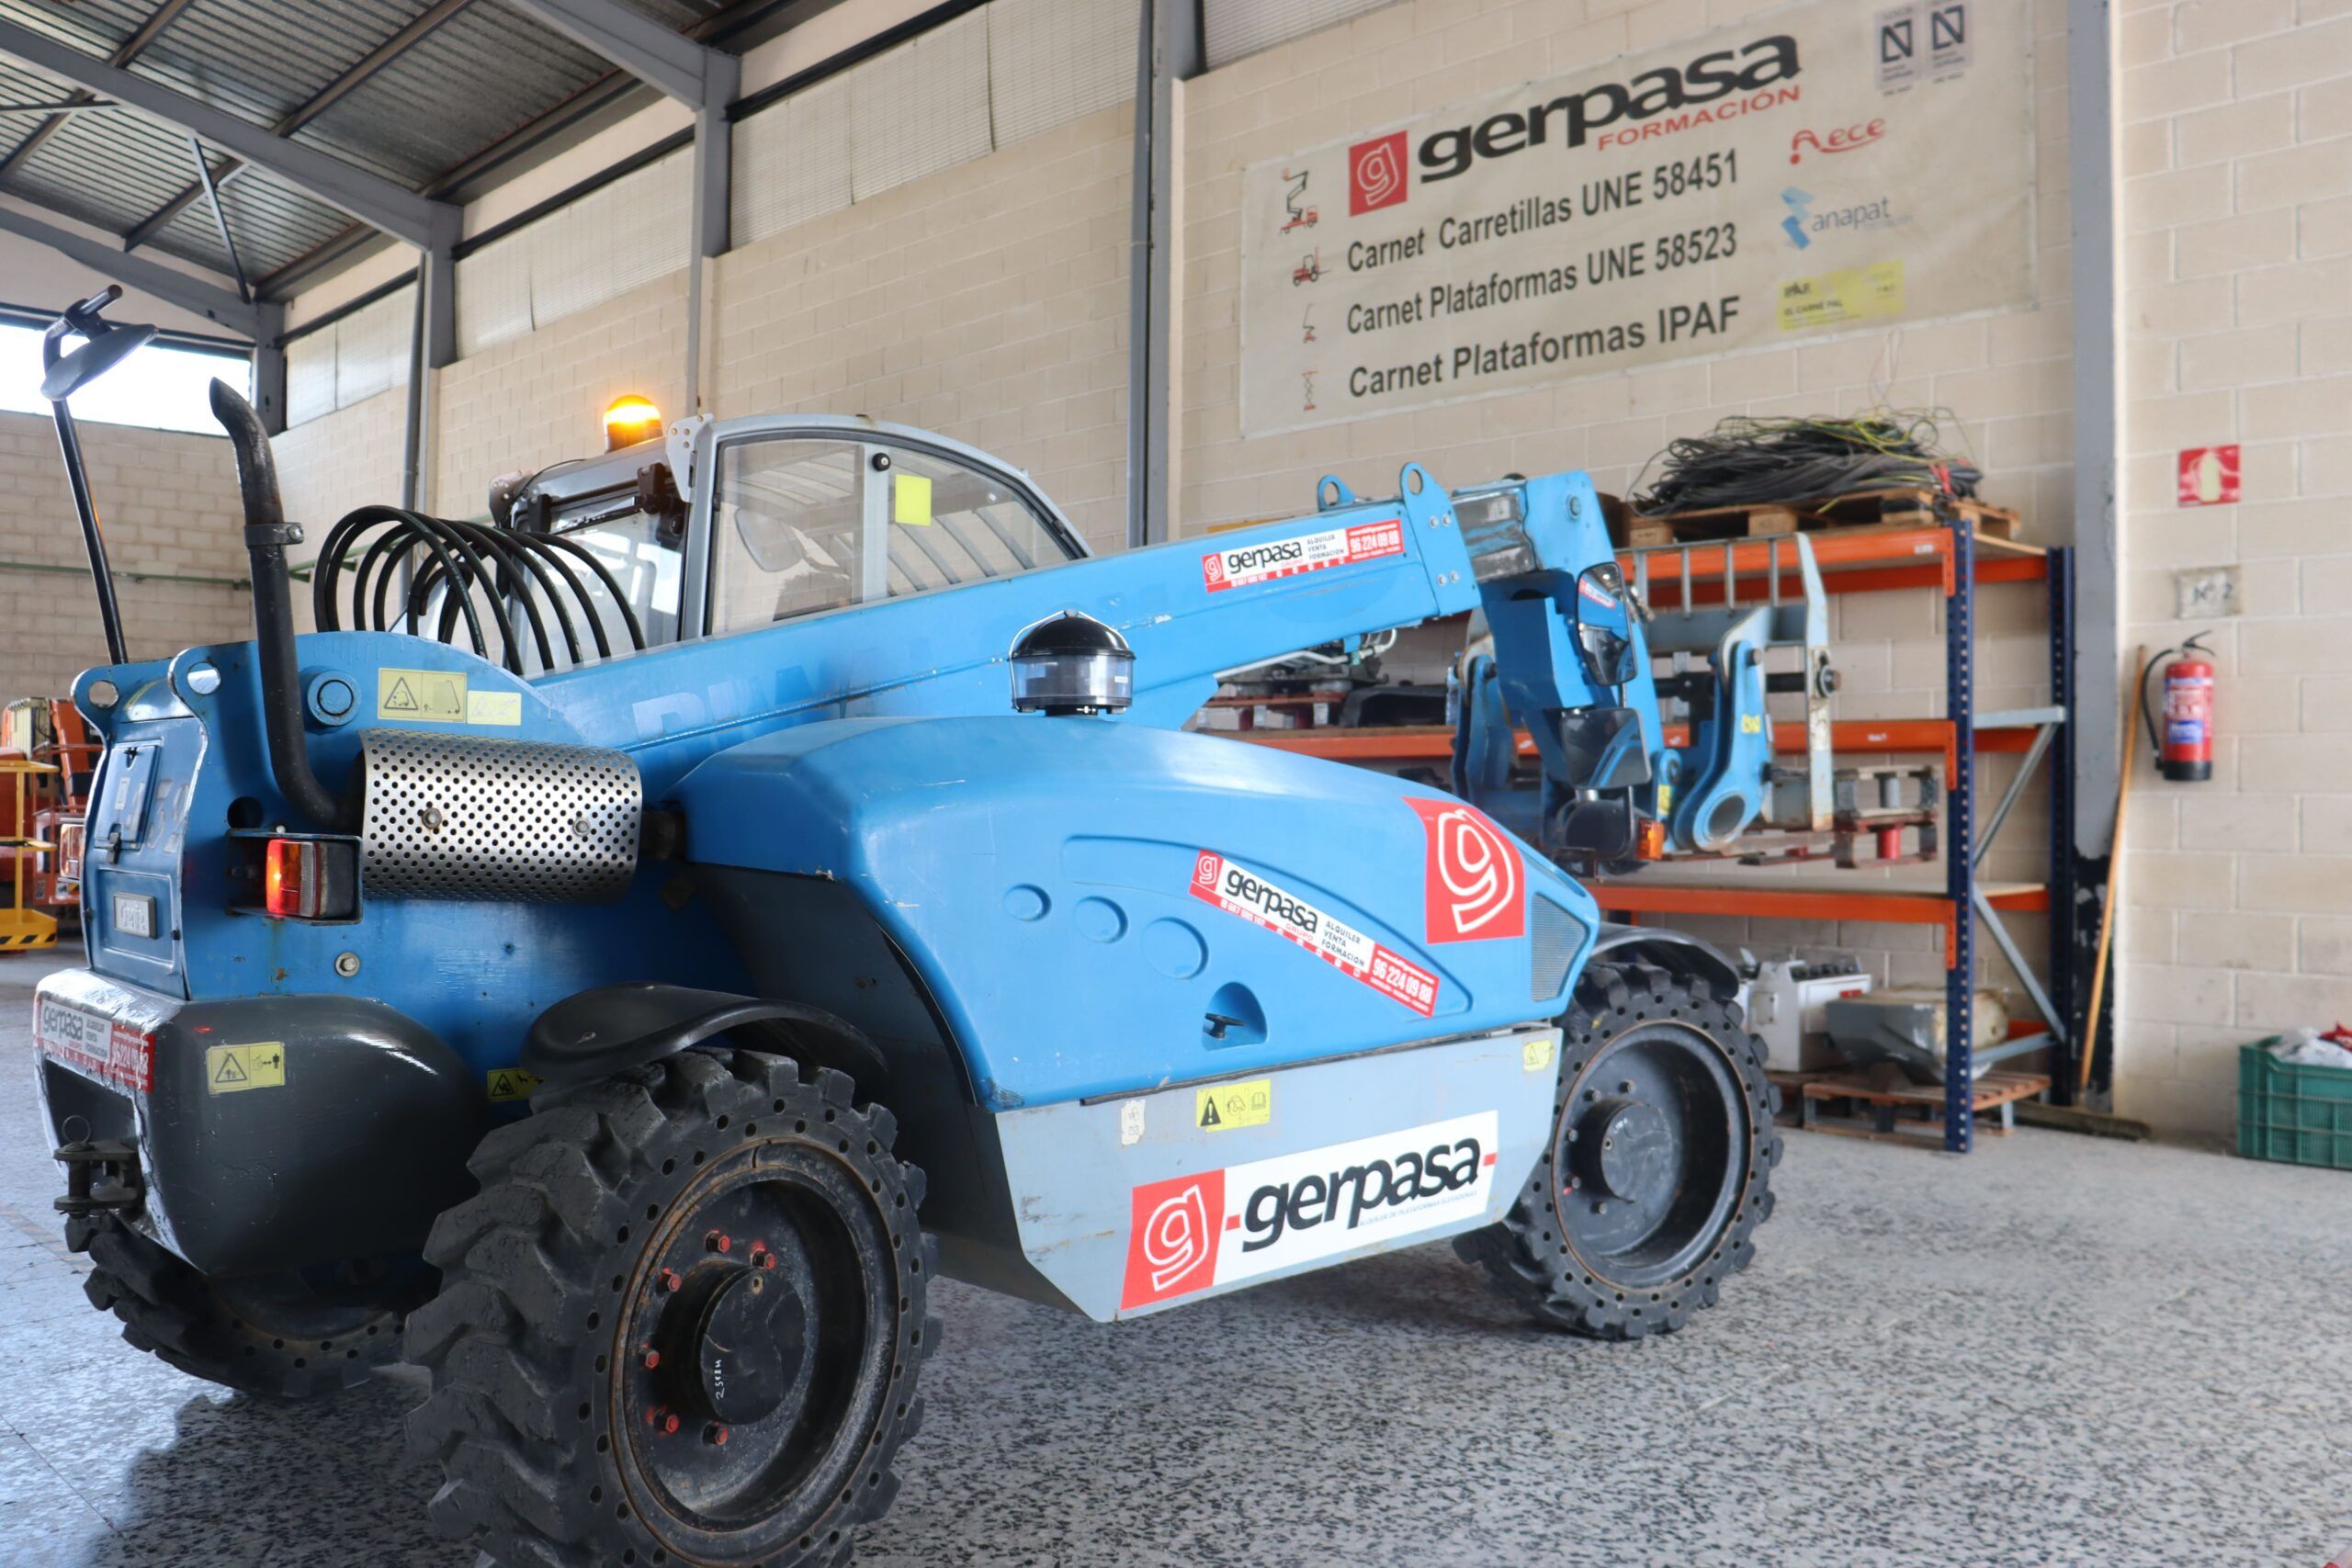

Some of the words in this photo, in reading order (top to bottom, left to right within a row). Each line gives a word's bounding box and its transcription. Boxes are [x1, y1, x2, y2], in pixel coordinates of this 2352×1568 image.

[1418, 35, 1802, 184] gerpasa
[1598, 85, 1801, 152] FORMACIÓN
[1347, 227, 1425, 273] Carnet
[1438, 197, 1572, 249] Carretillas
[1582, 172, 1643, 216] UNE
[1653, 148, 1738, 199] 58451
[1811, 196, 1892, 231] anapat
[1347, 289, 1423, 334] Carnet
[1430, 264, 1577, 318] Plataformas
[1586, 242, 1645, 285] UNE
[1655, 222, 1736, 270] 58523
[1348, 354, 1443, 398] Carnet
[1453, 321, 1646, 379] Plataformas
[1657, 296, 1741, 344] IPAF
[1228, 541, 1303, 574] gerpasa
[1308, 545, 1327, 553] VENTA
[1437, 808, 1515, 933] g
[1225, 869, 1318, 933] gerpasa
[1285, 923, 1314, 942] GRUPO
[1324, 930, 1347, 947] VENTA
[1326, 920, 1361, 944] ALQUILER
[1373, 958, 1387, 980] 96
[1386, 965, 1406, 990] 224
[1406, 976, 1419, 998] 09
[1419, 983, 1433, 1004] 88
[43, 1005, 84, 1041] gerpasa
[1143, 1185, 1210, 1292] g
[1242, 1138, 1480, 1253] gerpasa
